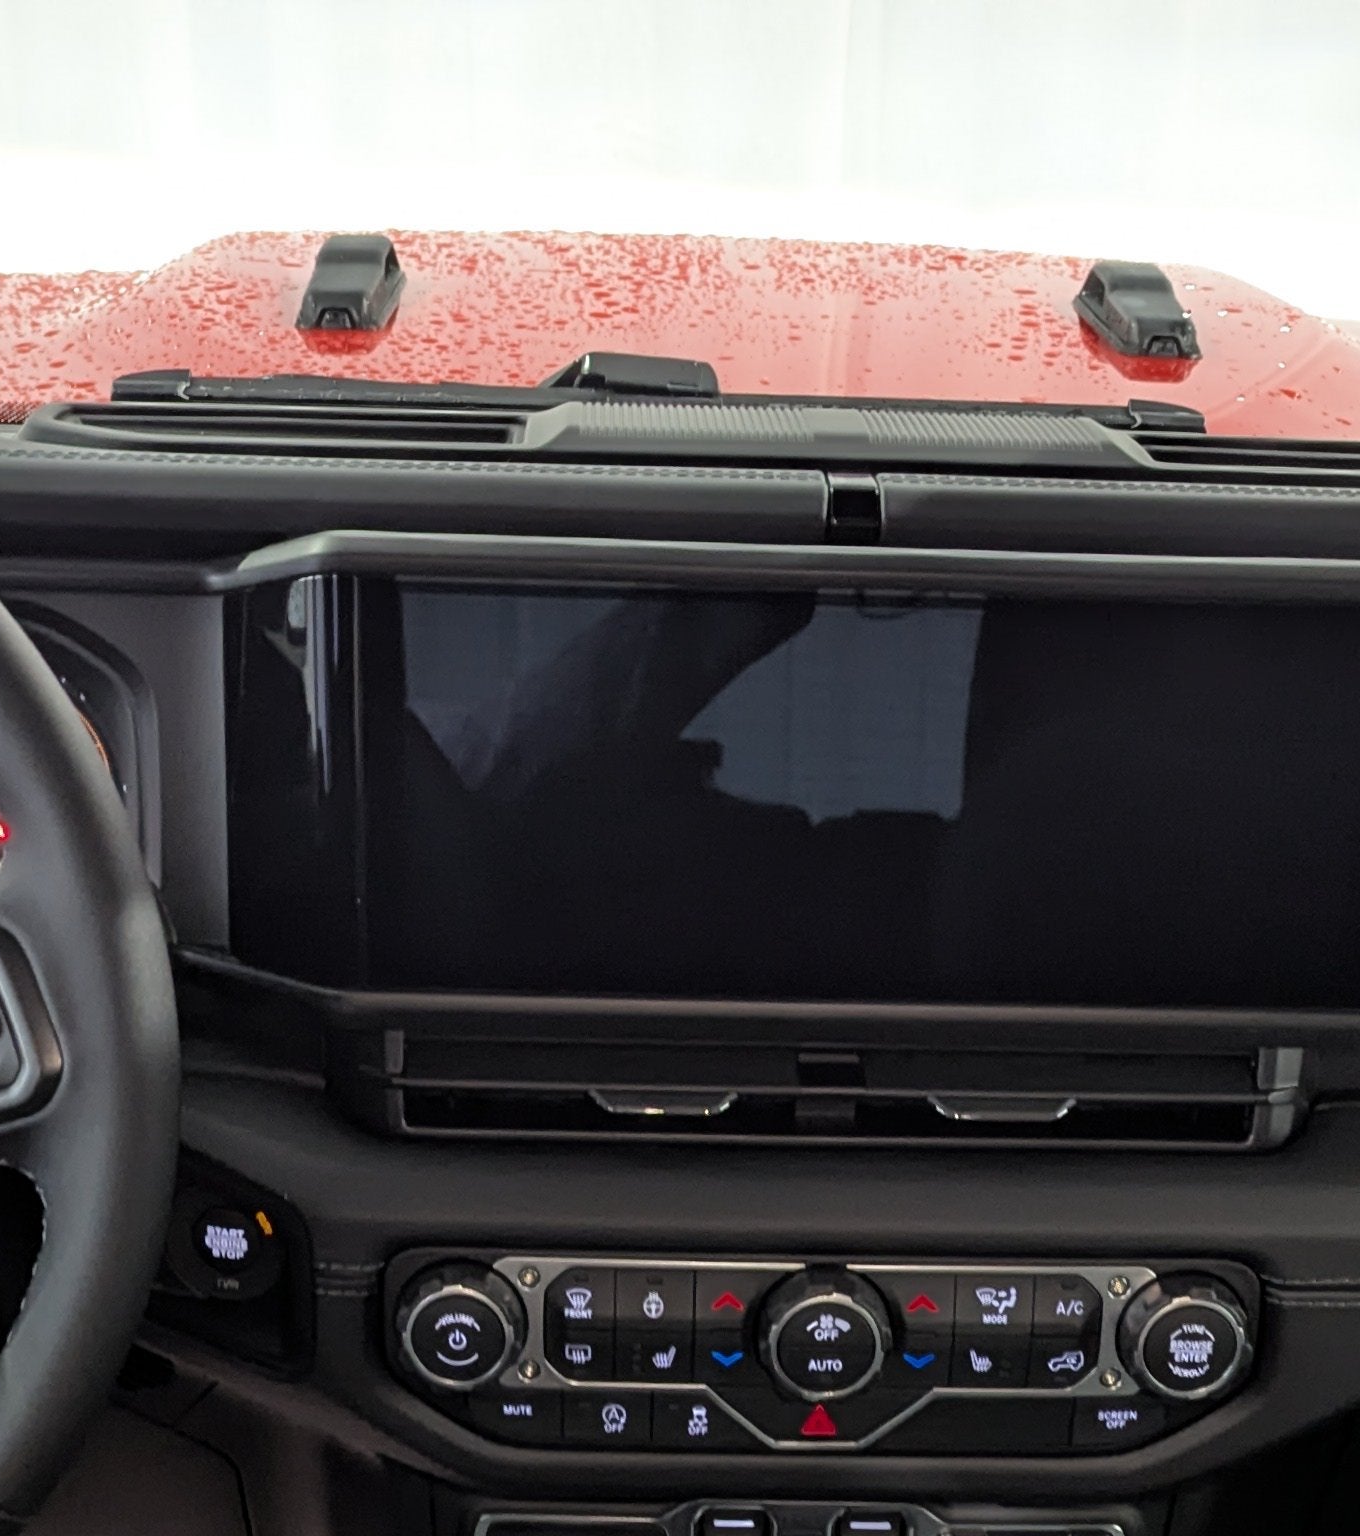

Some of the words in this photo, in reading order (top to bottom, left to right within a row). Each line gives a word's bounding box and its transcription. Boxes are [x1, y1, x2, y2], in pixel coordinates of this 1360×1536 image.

[206, 1224, 245, 1238] START
[204, 1235, 249, 1251] ENGINE
[211, 1247, 245, 1260] STOP
[564, 1308, 593, 1320] FRONT
[1055, 1299, 1085, 1317] A/C
[982, 1313, 1008, 1326] MODE
[814, 1329, 839, 1342] OFF
[1169, 1339, 1214, 1351] BROWSE
[1173, 1351, 1209, 1364] ENTER
[807, 1358, 843, 1373] AUTO
[1171, 1363, 1210, 1379] SCROLL
[503, 1404, 533, 1417] MUTE
[1097, 1409, 1138, 1422] SCREEN
[603, 1423, 625, 1434] OFF
[688, 1424, 708, 1436] OFF
[1104, 1418, 1127, 1430] OFF
